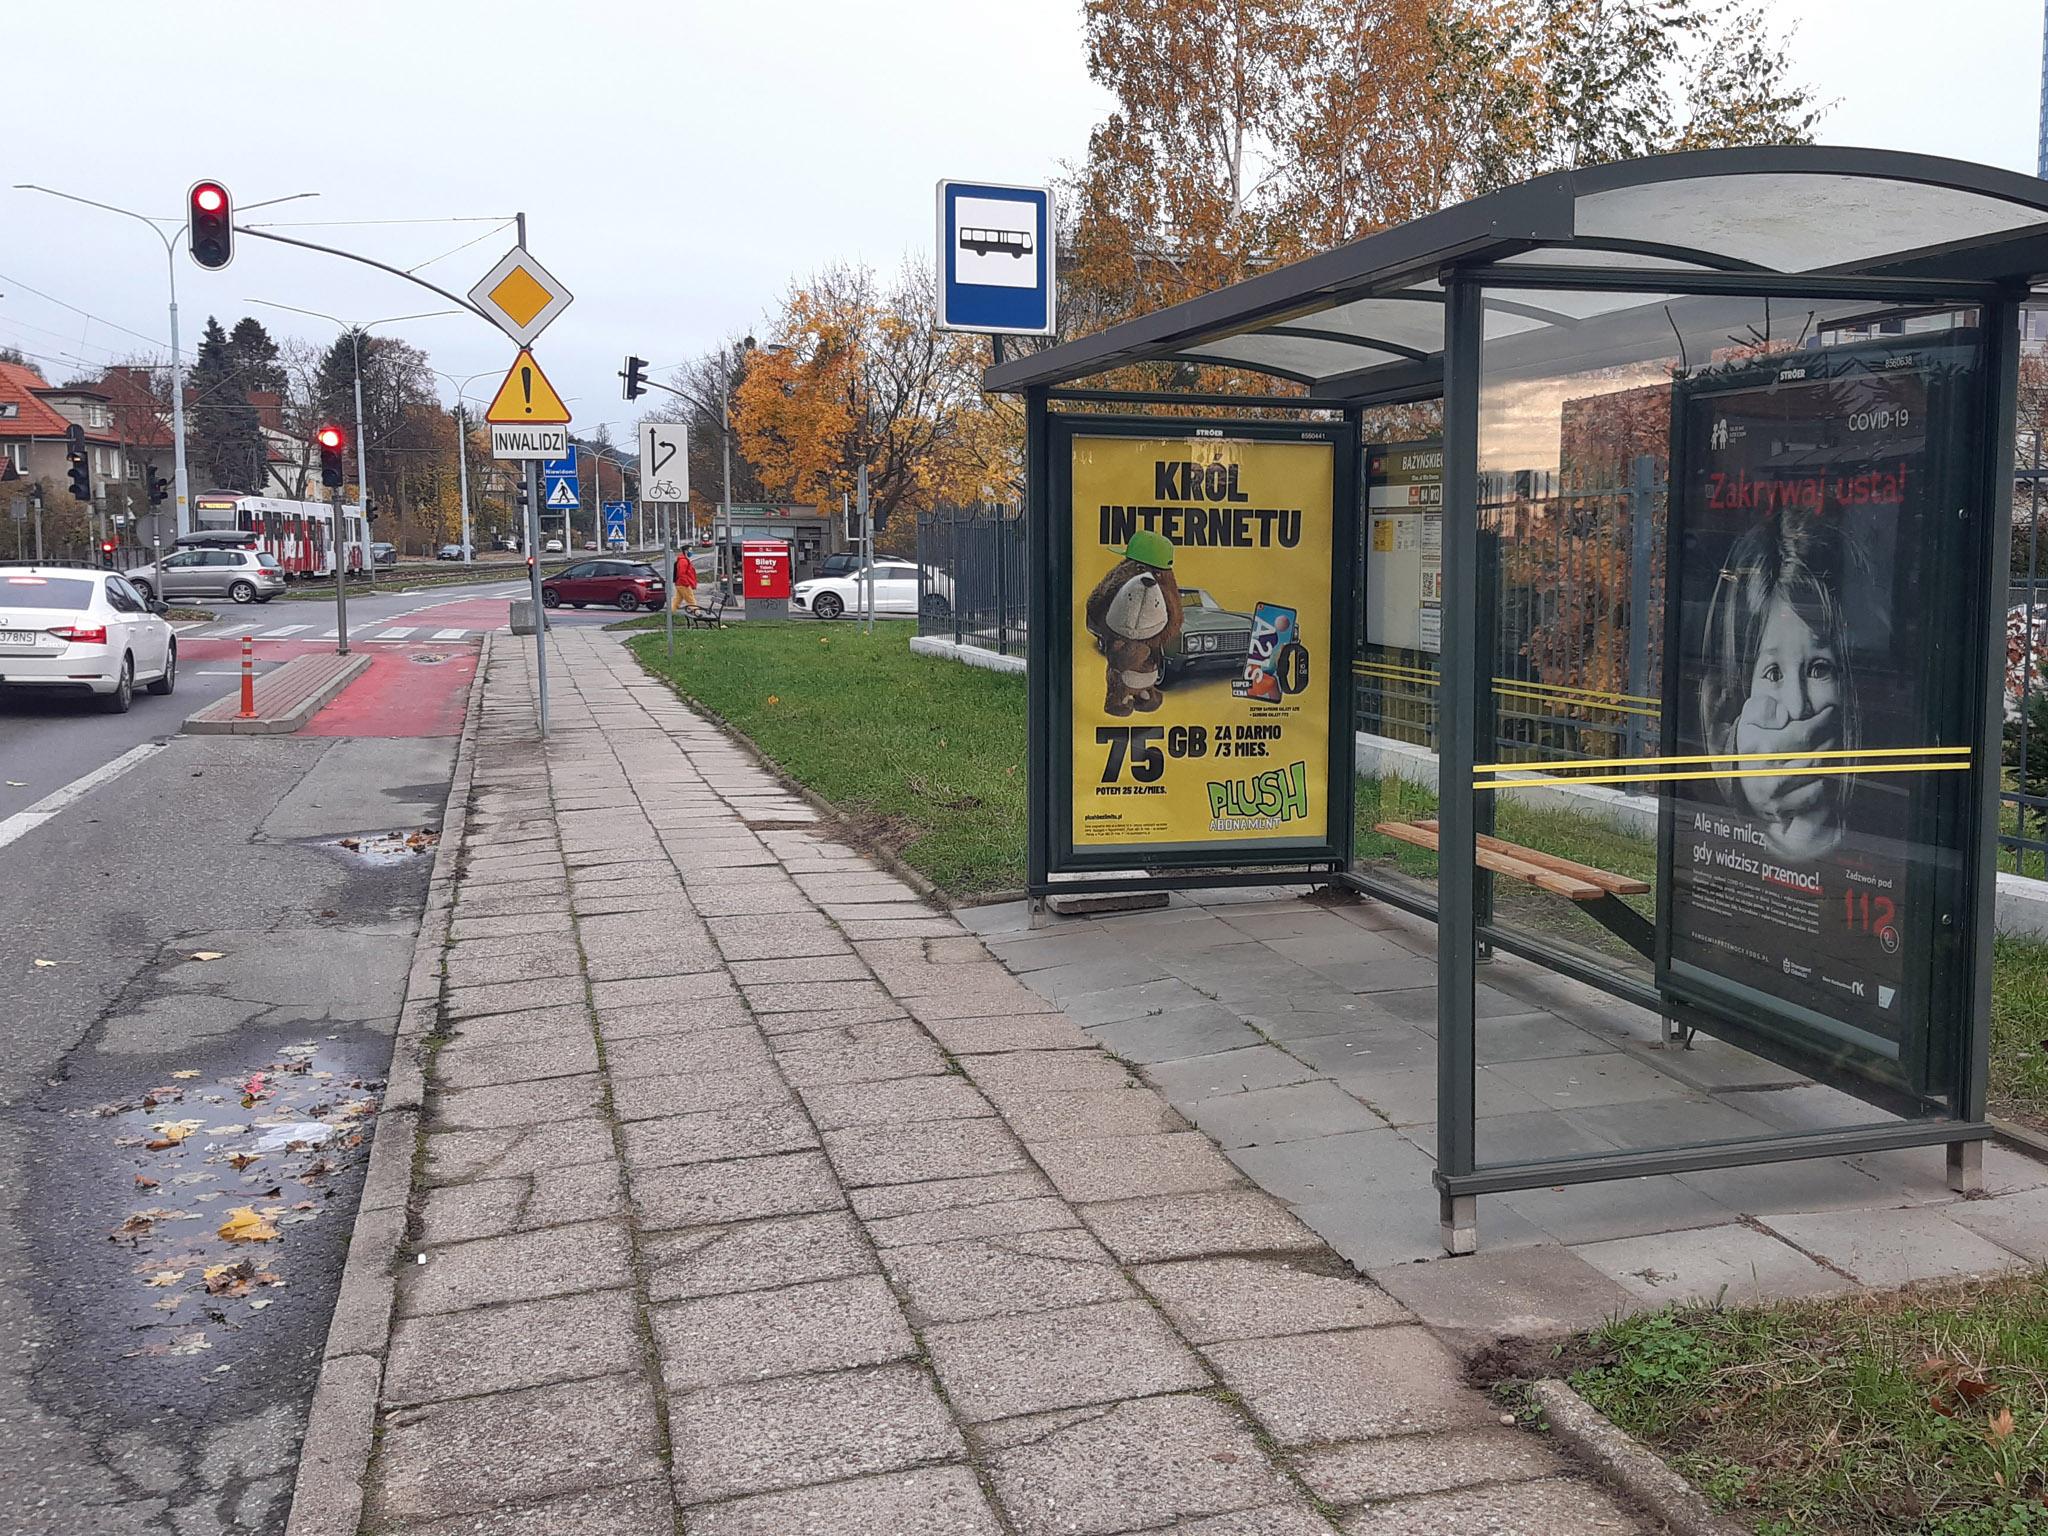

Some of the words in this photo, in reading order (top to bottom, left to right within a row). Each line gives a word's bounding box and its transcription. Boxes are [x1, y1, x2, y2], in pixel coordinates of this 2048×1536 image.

[1848, 408, 1909, 432] COVID-19
[495, 432, 564, 451] INWALIDZI
[1155, 453, 1249, 503] KRÓL
[1709, 467, 1825, 518] Zakrywaj
[1836, 462, 1907, 505] usta!
[1099, 505, 1302, 549] INTERNETU
[755, 558, 777, 567] Bilety
[1232, 680, 1252, 688] SUPER-
[1232, 689, 1248, 697] CENA
[1167, 725, 1208, 759] GB
[1214, 725, 1232, 740] ZA
[1235, 725, 1282, 741] DARMO
[1095, 726, 1165, 783] 75
[1214, 742, 1231, 757] /3
[1235, 742, 1270, 758] MIES.
[1095, 787, 1121, 796] POTEM
[1122, 787, 1132, 795] 25
[1133, 786, 1167, 795] ZŁ/MIES.
[1207, 761, 1308, 822] PLUSH
[1208, 816, 1281, 832] ABONAMENT
[1694, 812, 1712, 833] Ale
[1713, 818, 1730, 838] nie
[1733, 823, 1767, 851] milcz,
[1693, 841, 1713, 866] gdy
[1715, 848, 1760, 875] widzisz
[1762, 862, 1820, 891] przemoc!
[1845, 869, 1876, 886] Zadzwoń
[1877, 878, 1893, 889] pod
[1845, 886, 1896, 937] 112
